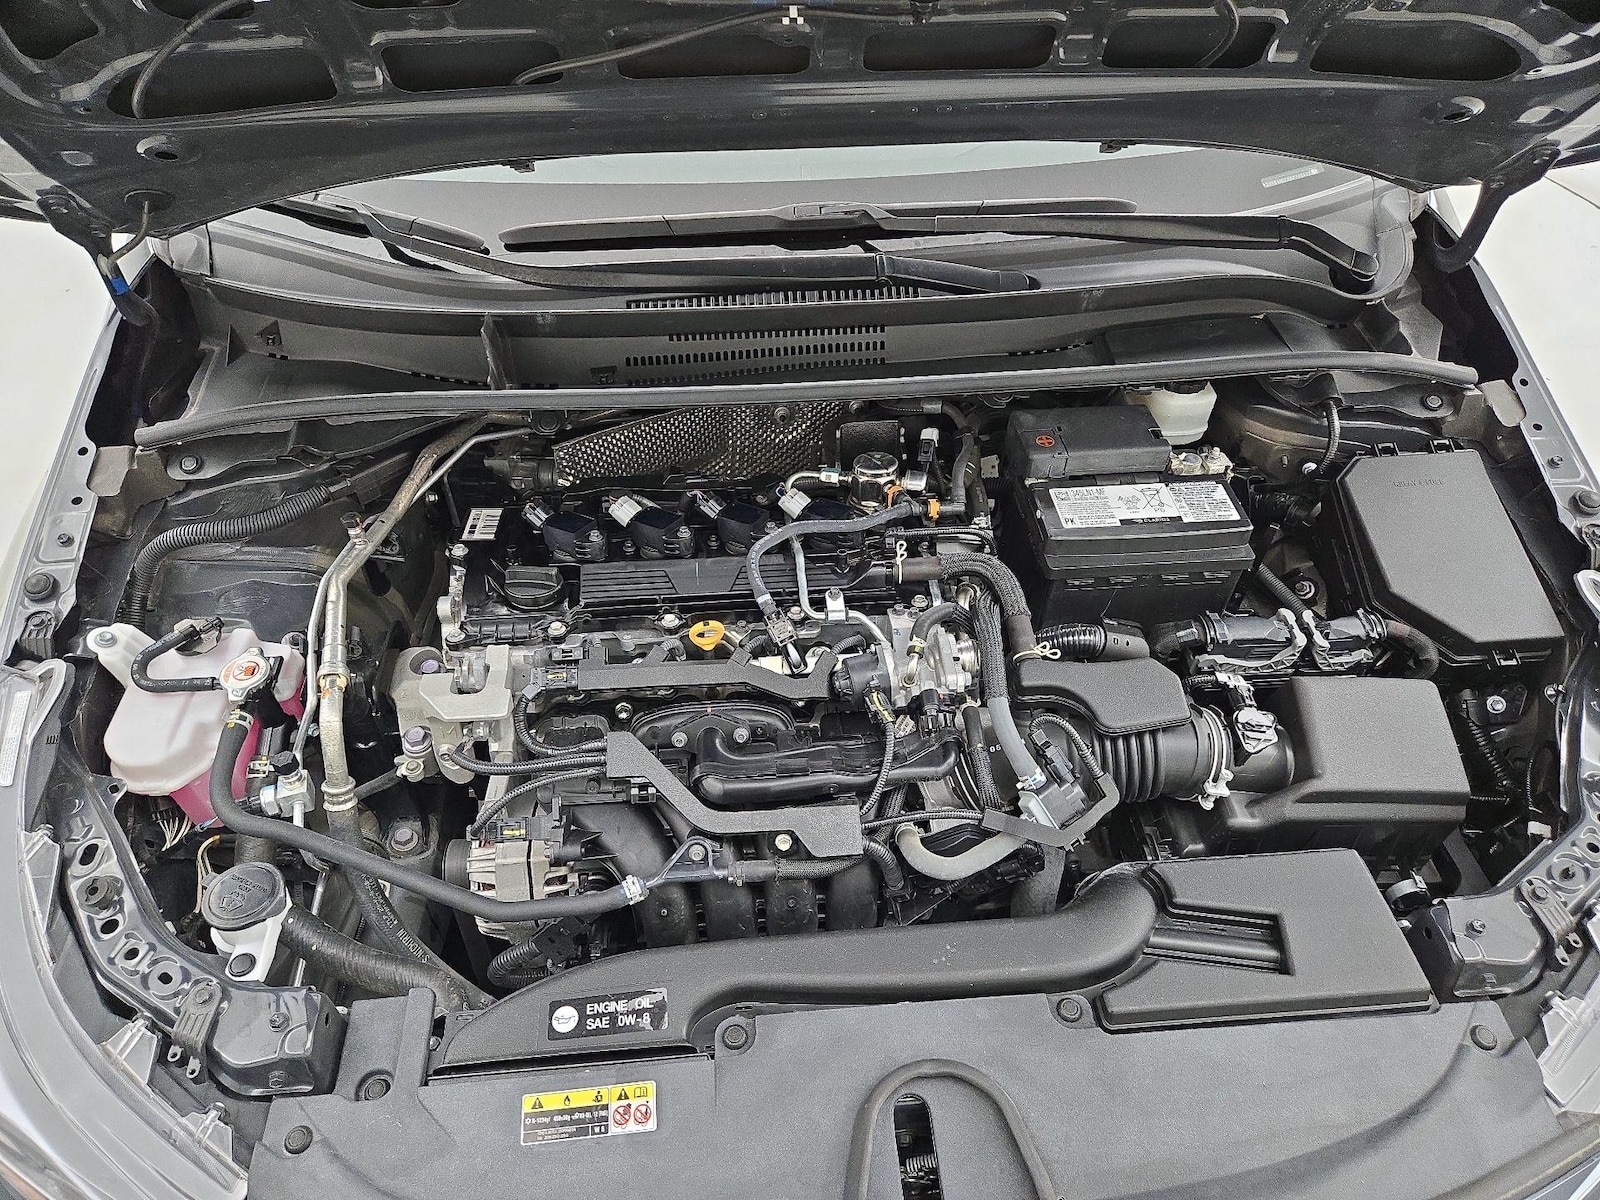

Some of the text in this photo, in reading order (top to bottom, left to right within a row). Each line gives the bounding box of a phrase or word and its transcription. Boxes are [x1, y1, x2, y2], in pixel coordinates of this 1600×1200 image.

[1064, 517, 1077, 526] PK
[586, 997, 655, 1015] ENGINE OIL
[586, 1012, 652, 1030] SAE 0W-8
